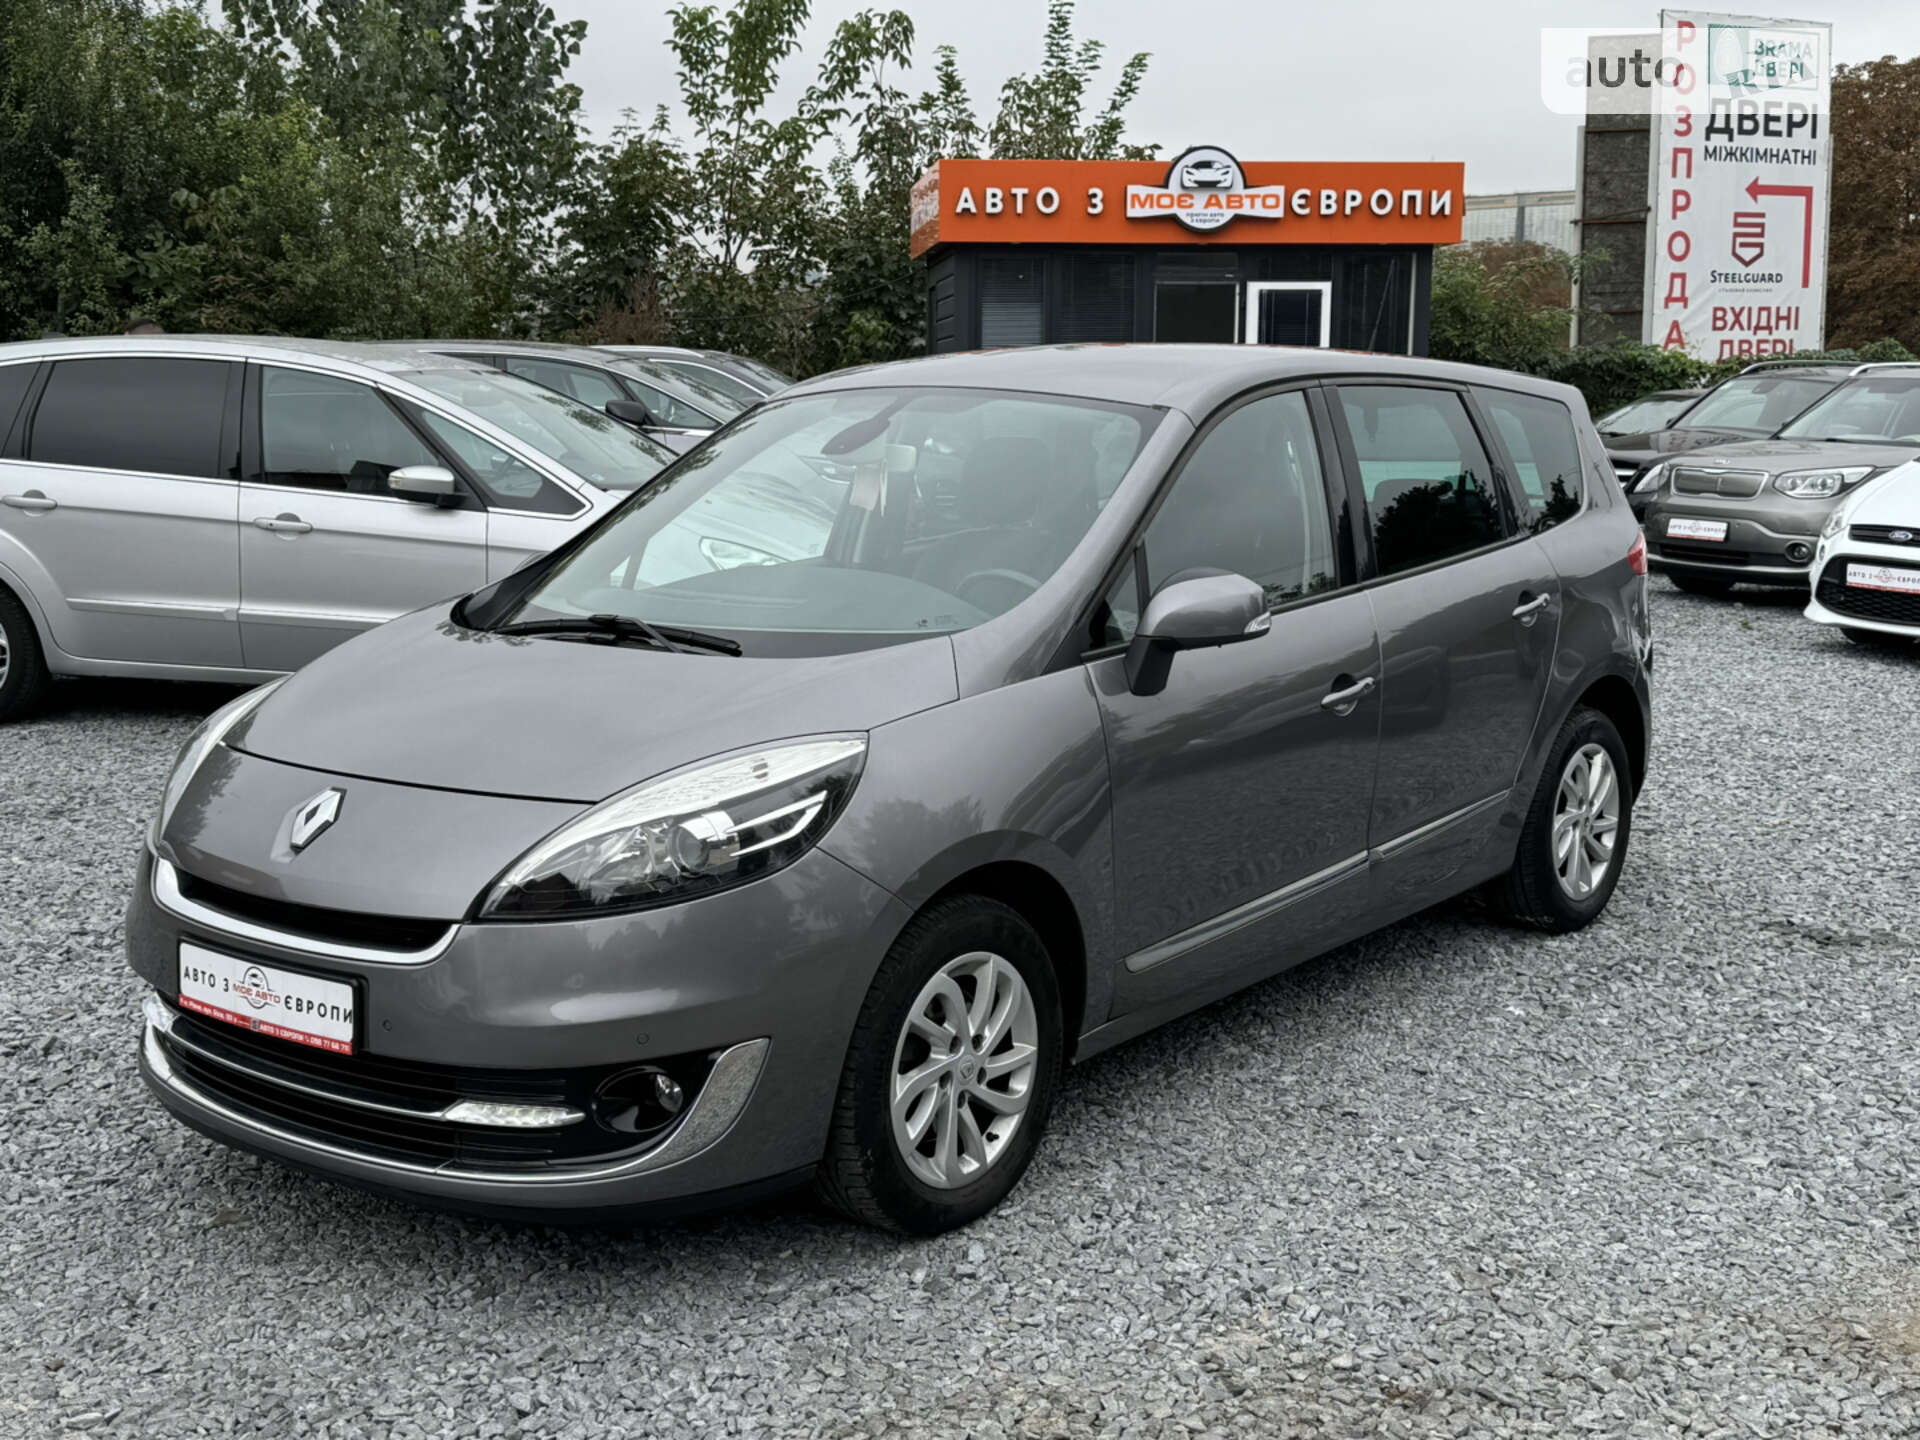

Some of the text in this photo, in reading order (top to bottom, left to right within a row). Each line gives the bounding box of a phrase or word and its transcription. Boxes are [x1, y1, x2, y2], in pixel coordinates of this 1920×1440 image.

[1704, 98, 1818, 142] ДВЕРІ
[1704, 145, 1817, 166] МІЖКІМНАТНІ
[954, 186, 1104, 216] АВТО З
[1130, 193, 1281, 210] МОЄ АВТО
[1290, 187, 1453, 217] ЄВРОПИ
[1712, 306, 1800, 336] ВХІДНІ
[184, 965, 217, 989] АВТО
[284, 994, 353, 1025] ЄВРОПИ
